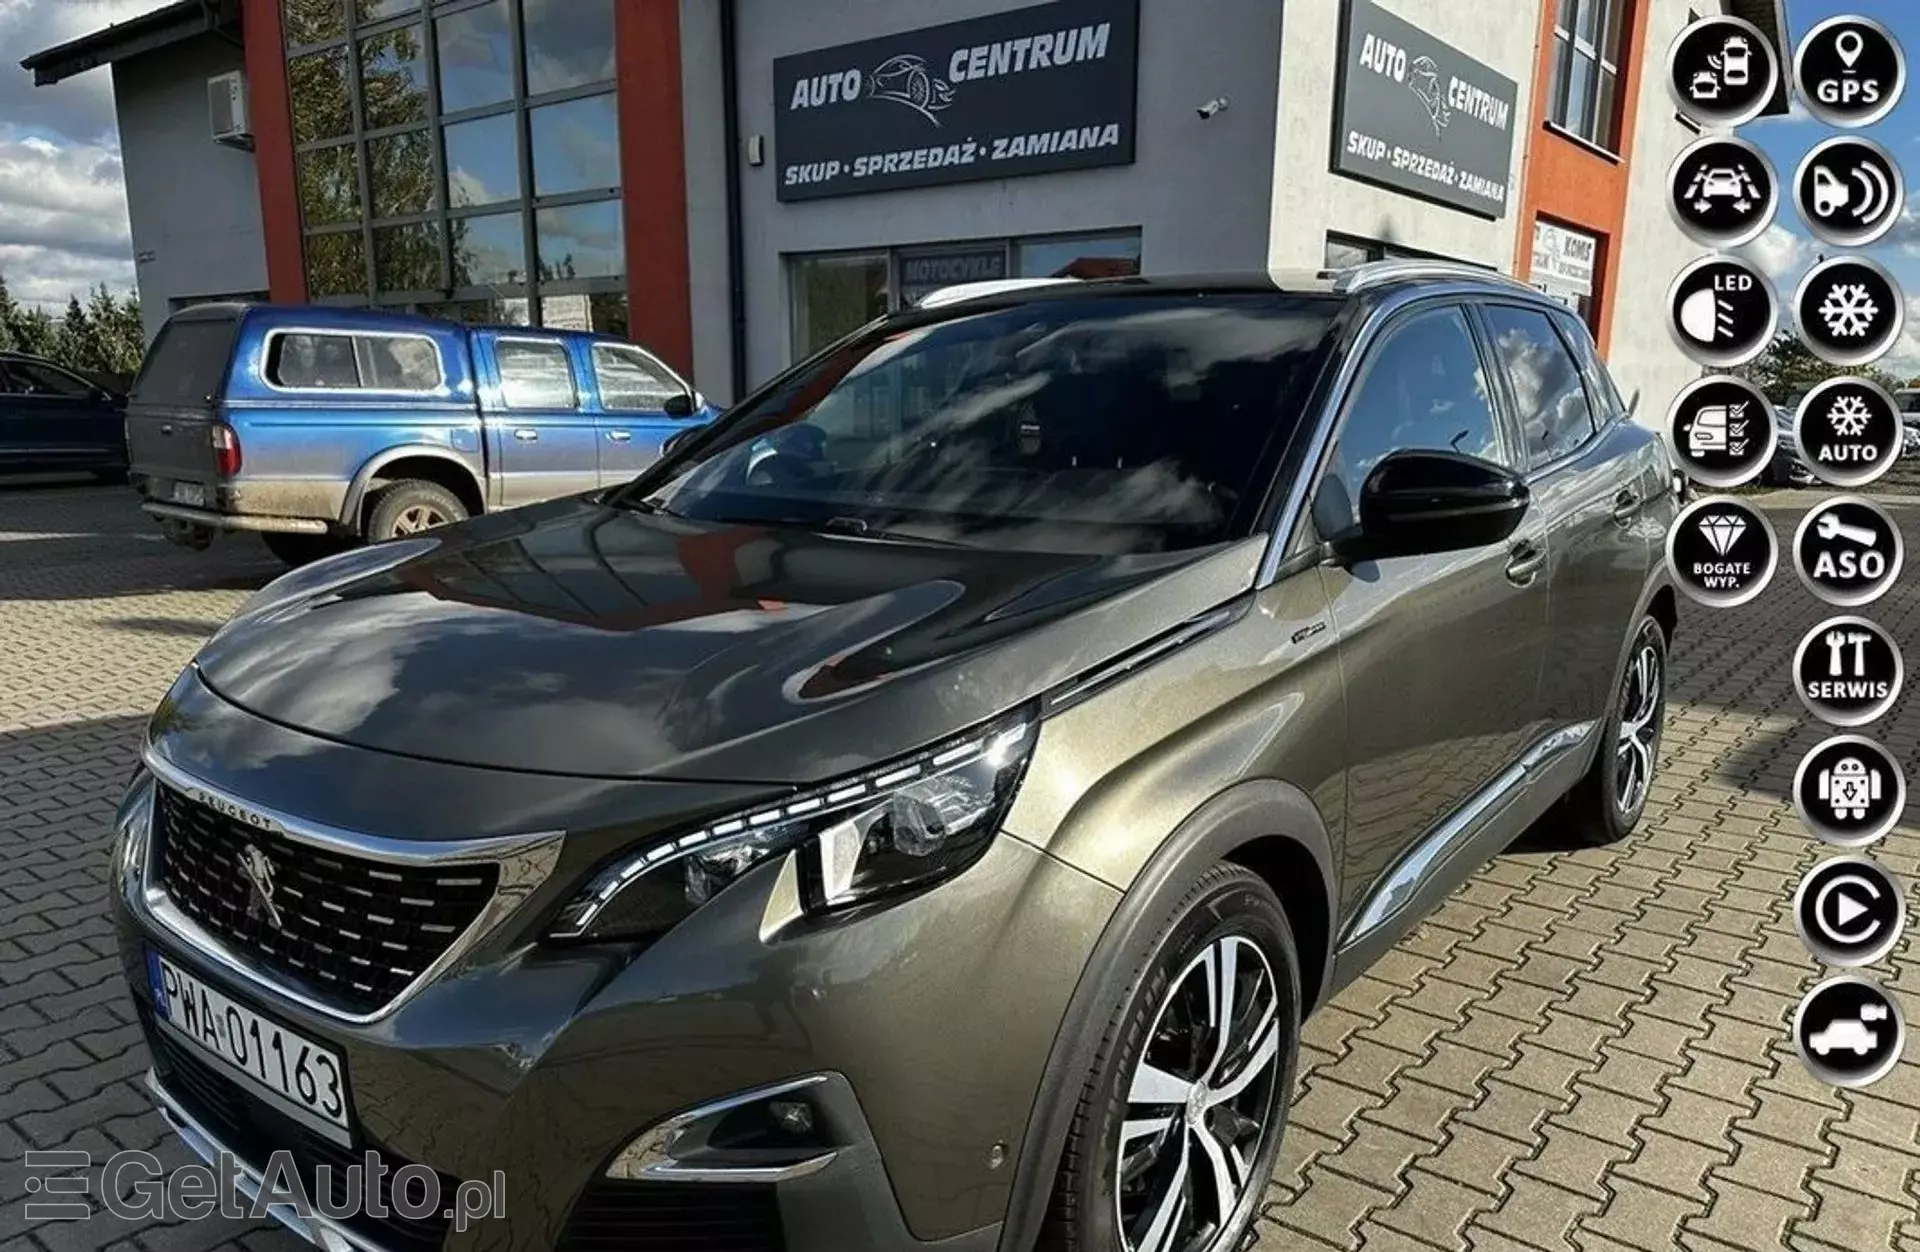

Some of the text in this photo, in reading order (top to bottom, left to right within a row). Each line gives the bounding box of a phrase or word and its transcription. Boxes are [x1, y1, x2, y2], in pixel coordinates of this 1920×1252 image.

[790, 23, 1110, 110] AUTO CENTRUM
[1359, 33, 1510, 130] AUTO CENTRUM
[785, 123, 1119, 186] SKUP SPRZEDAŻ ZAMIANA
[1347, 130, 1504, 203] SKUP SPRZEDAŻ ZAMIANA
[905, 255, 1001, 282] MOTOCYKLE
